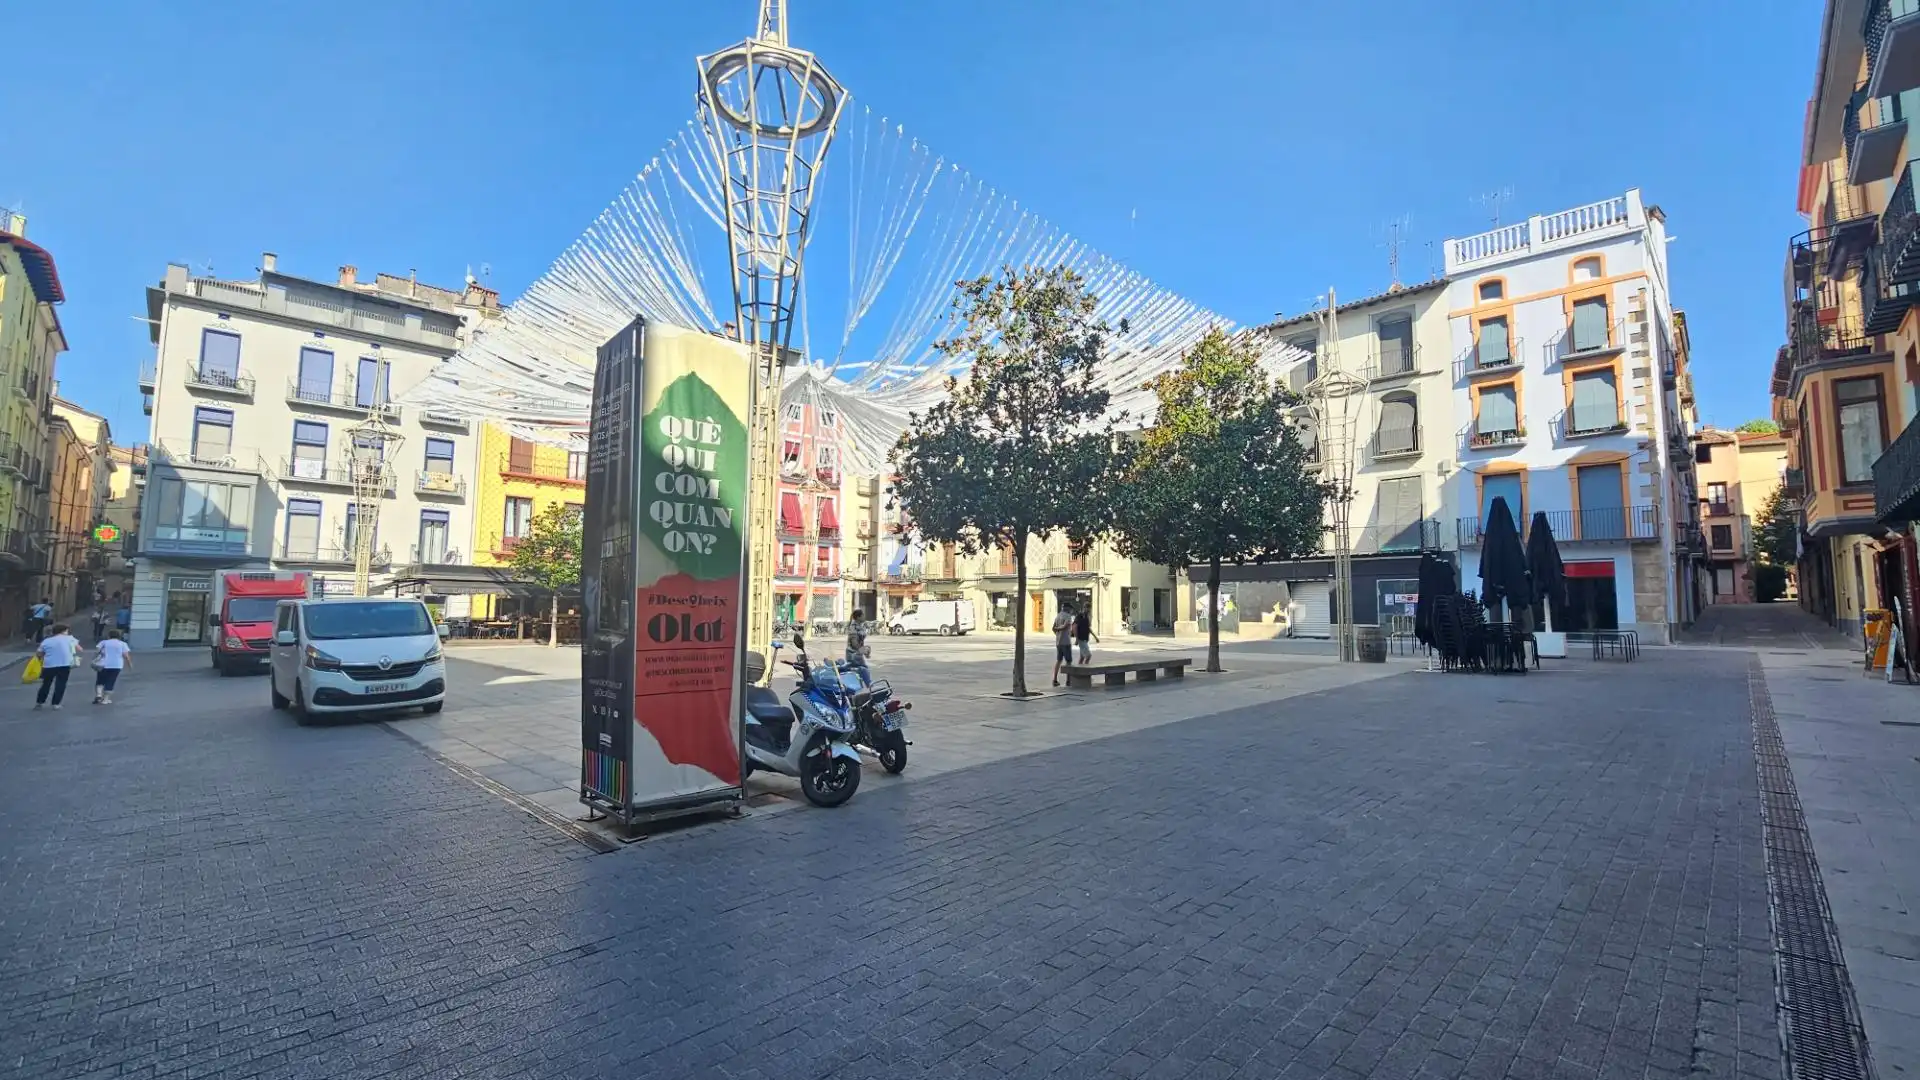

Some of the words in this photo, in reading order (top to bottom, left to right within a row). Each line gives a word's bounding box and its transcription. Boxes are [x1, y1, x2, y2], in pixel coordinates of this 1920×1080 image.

[660, 415, 721, 445] QUÈ
[662, 444, 717, 472] QUI
[655, 472, 722, 500] COM
[649, 500, 734, 528] QUAN
[663, 530, 717, 555] ON?
[647, 612, 726, 643] Olot
